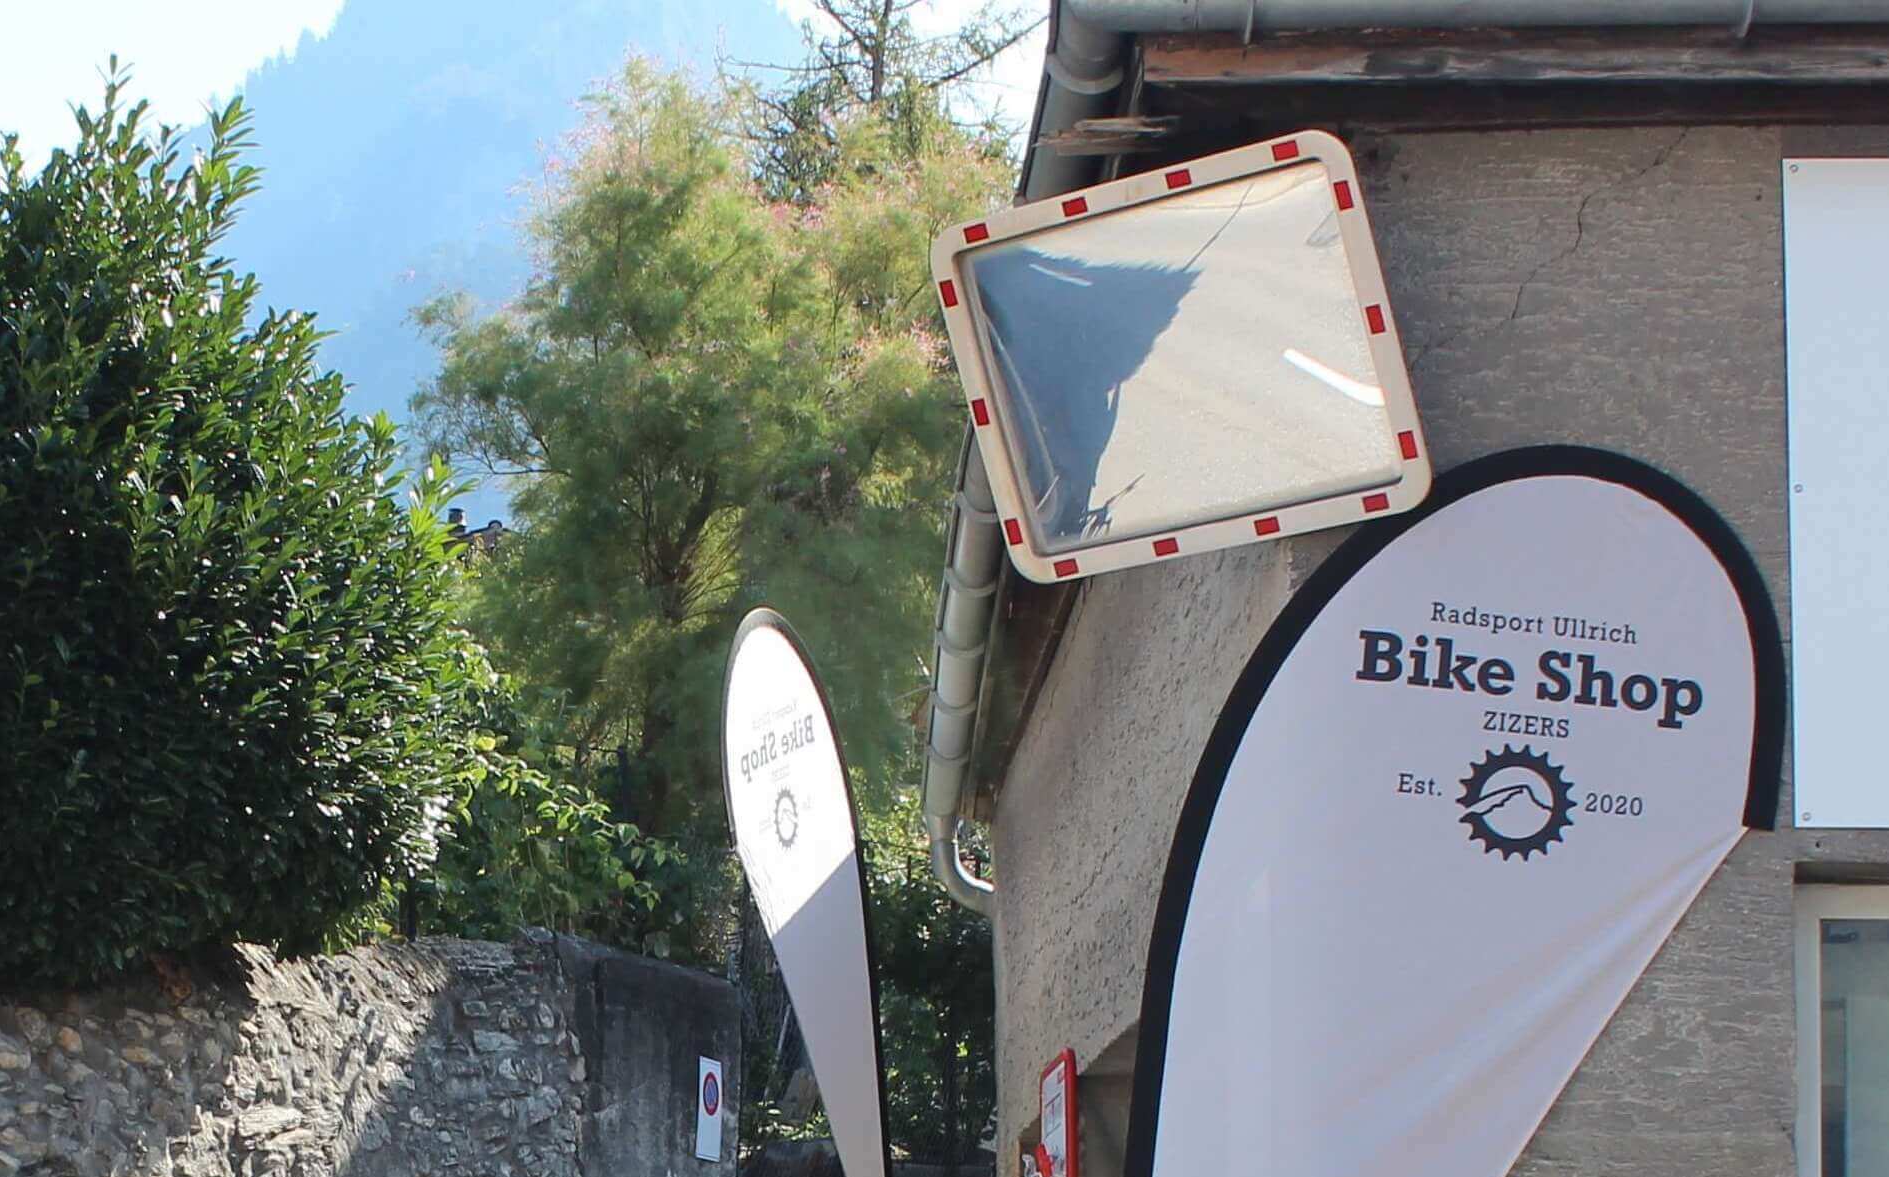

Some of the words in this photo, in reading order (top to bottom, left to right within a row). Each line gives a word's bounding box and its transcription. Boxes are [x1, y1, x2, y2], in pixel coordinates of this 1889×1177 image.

[1430, 601, 1544, 635] Radsport
[1552, 616, 1639, 645] Ullrich
[1355, 630, 1515, 696] Bike
[1535, 649, 1704, 729] Shop
[1482, 710, 1570, 739] ZIZERS
[1397, 772, 1443, 797] Est.
[1584, 792, 1644, 817] 2020
